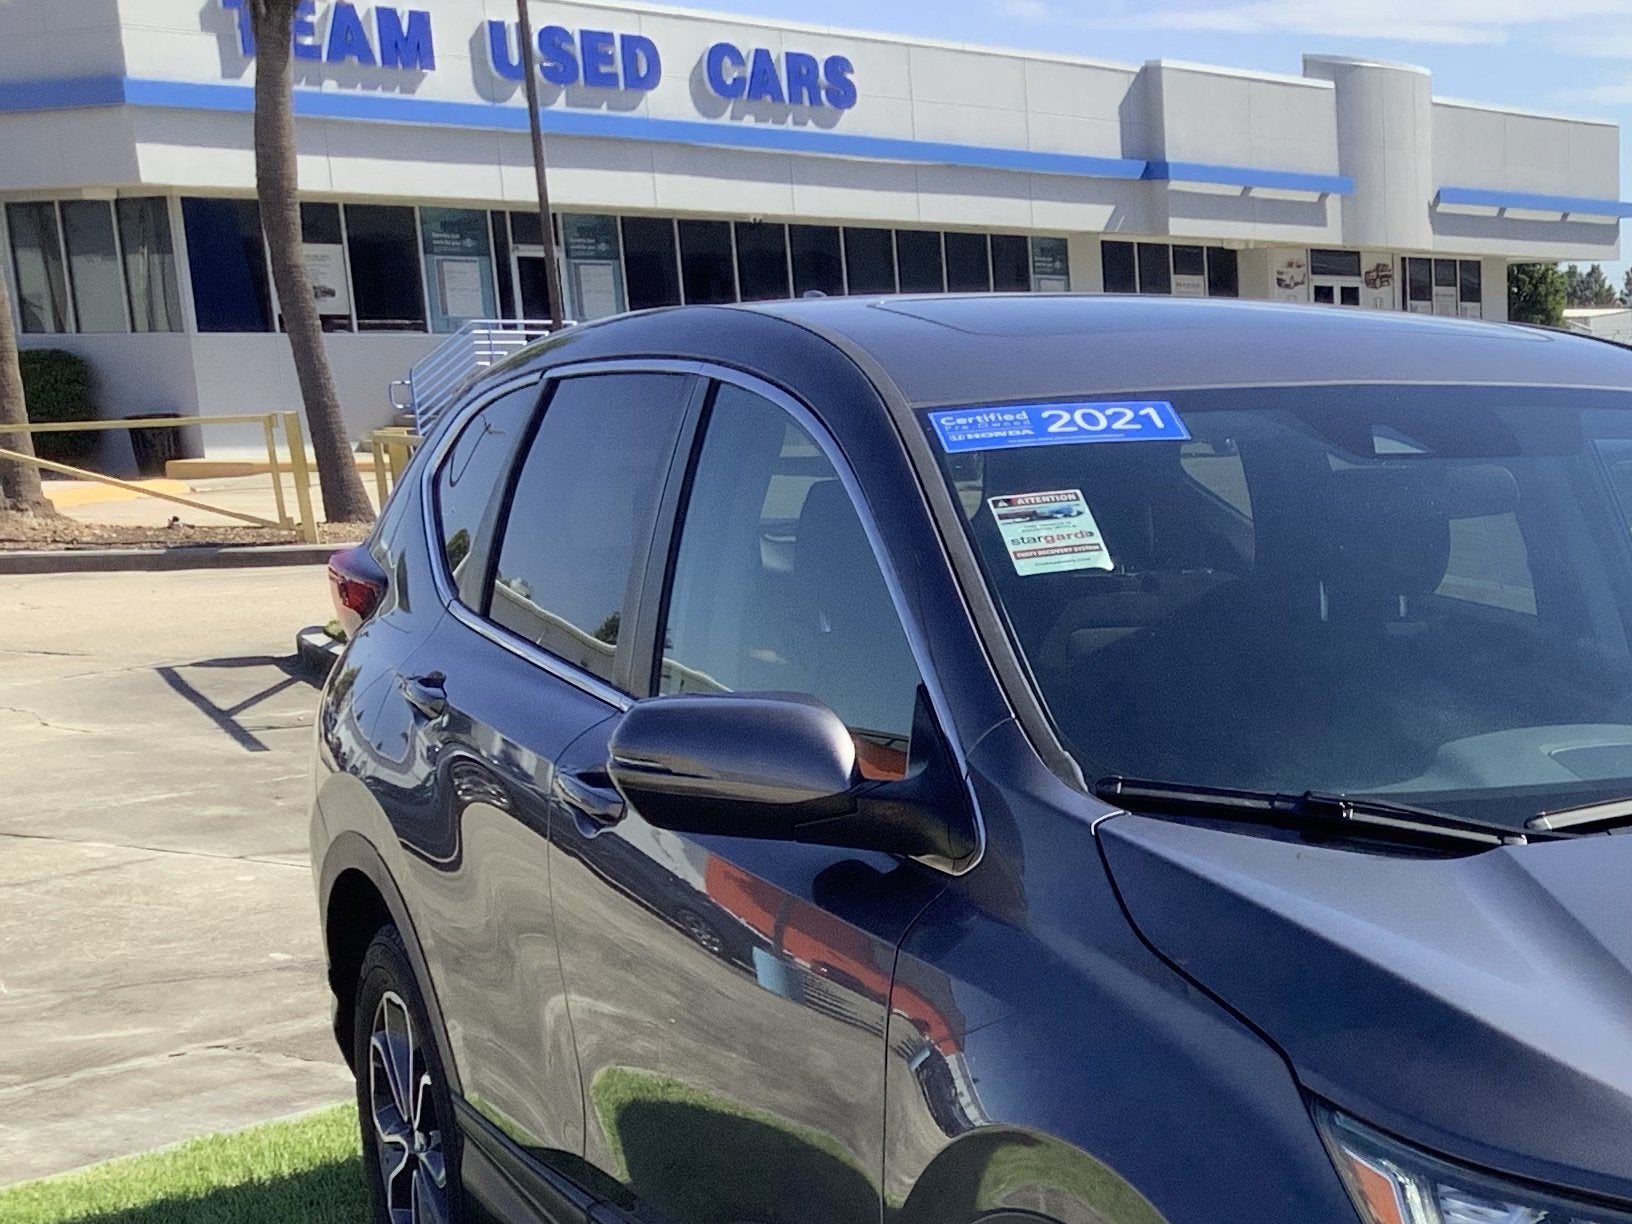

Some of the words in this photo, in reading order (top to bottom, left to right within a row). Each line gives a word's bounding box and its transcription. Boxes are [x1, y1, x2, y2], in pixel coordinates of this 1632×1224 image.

[487, 20, 661, 91] USED
[706, 42, 857, 109] CARS
[941, 410, 1029, 426] Certified
[1041, 407, 1165, 433] 2021
[966, 429, 1035, 440] HONDA
[1017, 493, 1077, 506] ATTENTION
